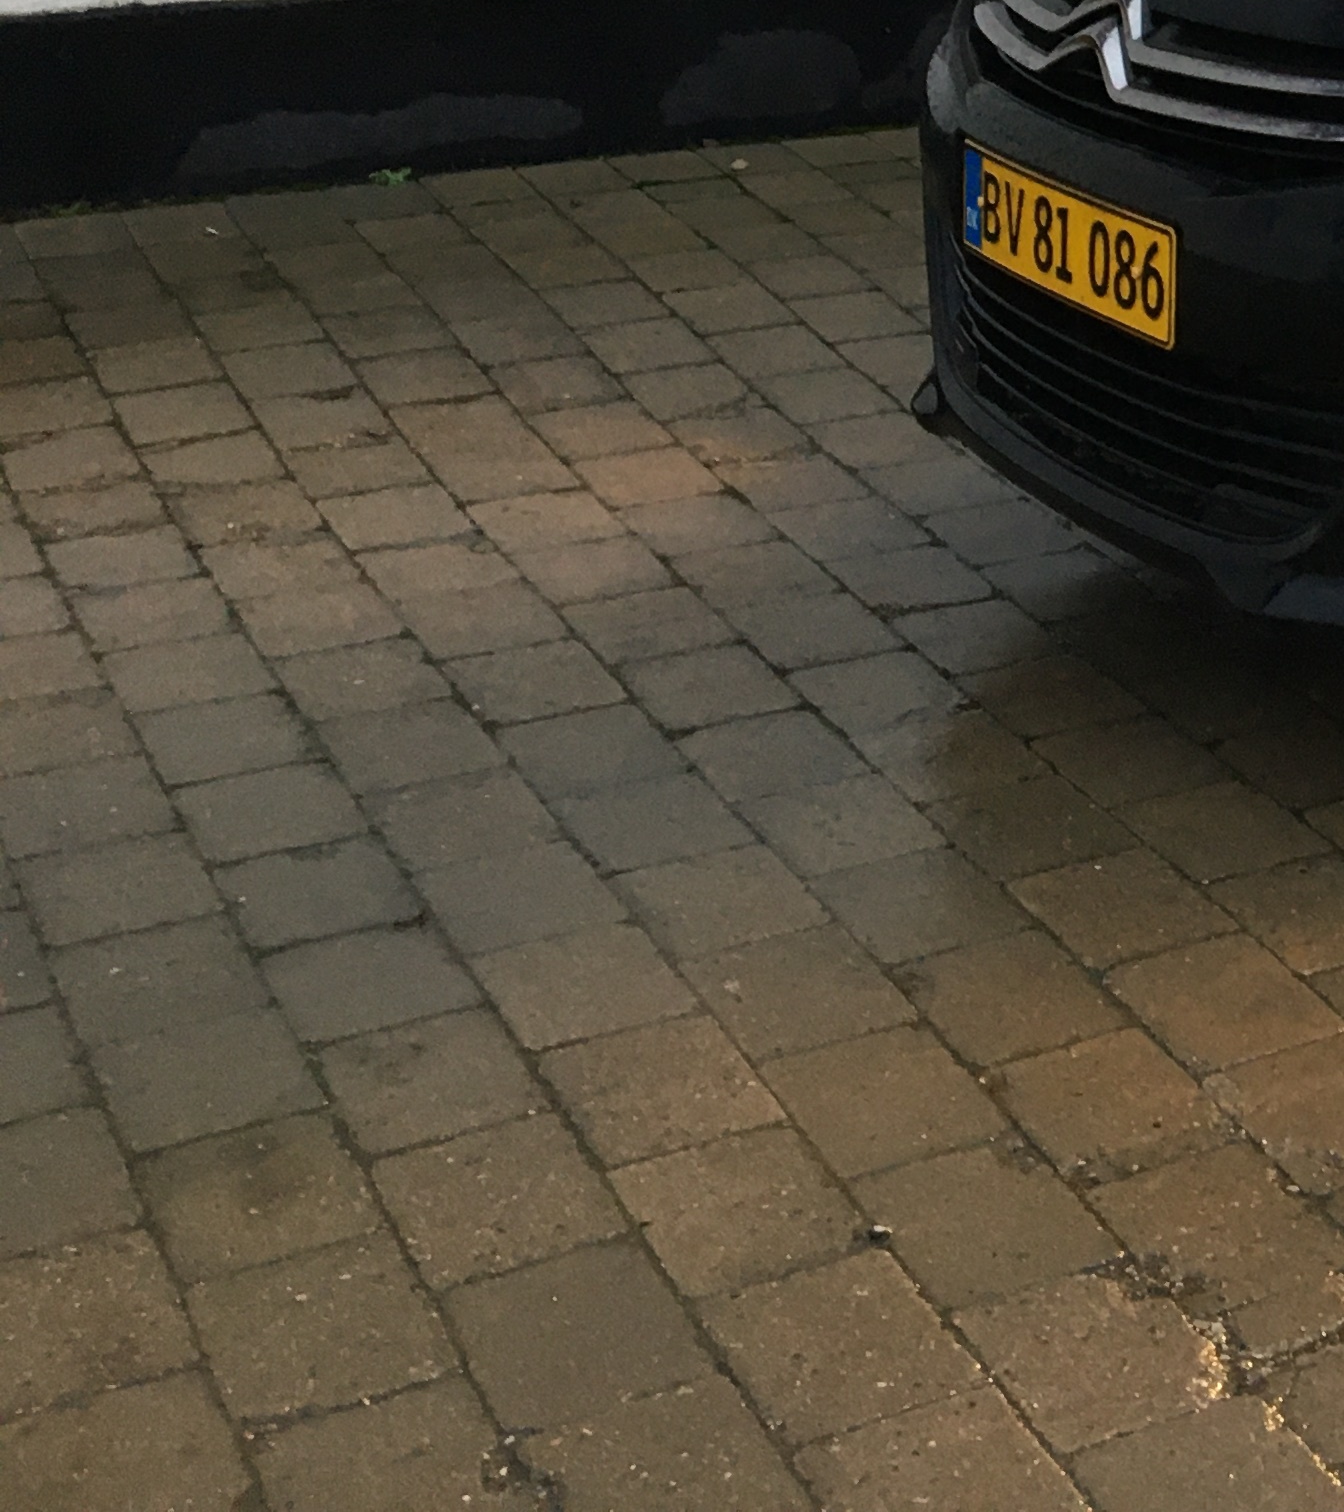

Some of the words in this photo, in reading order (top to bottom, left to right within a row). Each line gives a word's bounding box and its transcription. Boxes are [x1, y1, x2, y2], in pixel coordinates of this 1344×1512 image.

[983, 170, 1025, 257] BV
[1033, 195, 1073, 285] 81
[1088, 219, 1165, 322] 086
